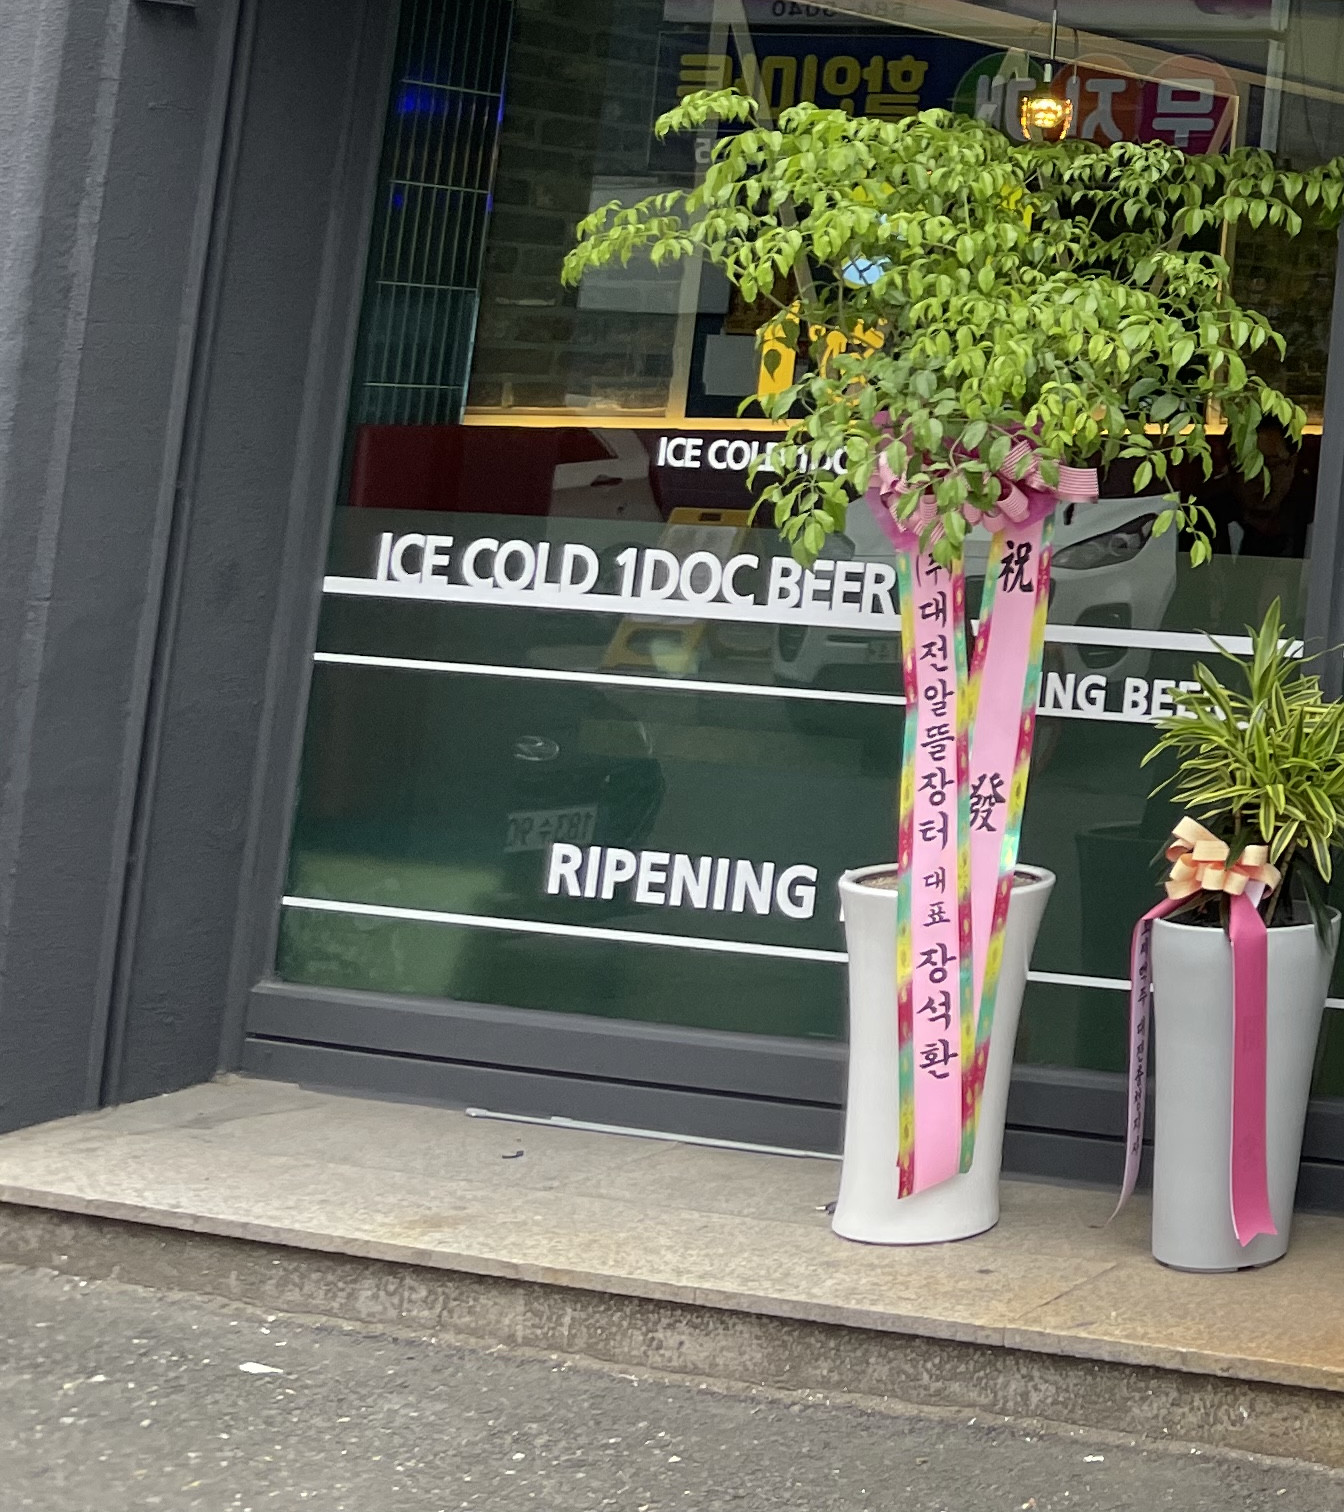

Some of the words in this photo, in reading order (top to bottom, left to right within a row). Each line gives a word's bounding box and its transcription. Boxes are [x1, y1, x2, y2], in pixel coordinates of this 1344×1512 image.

[656, 436, 703, 469] ICE
[377, 532, 454, 586] ICE
[462, 538, 599, 595] COLD
[615, 548, 759, 605] 1DOC
[767, 555, 899, 616] BEER
[998, 540, 1034, 593] 祝
[547, 842, 818, 919] RIPENING
[923, 867, 951, 928] 대표
[916, 942, 958, 1080] 장석환
